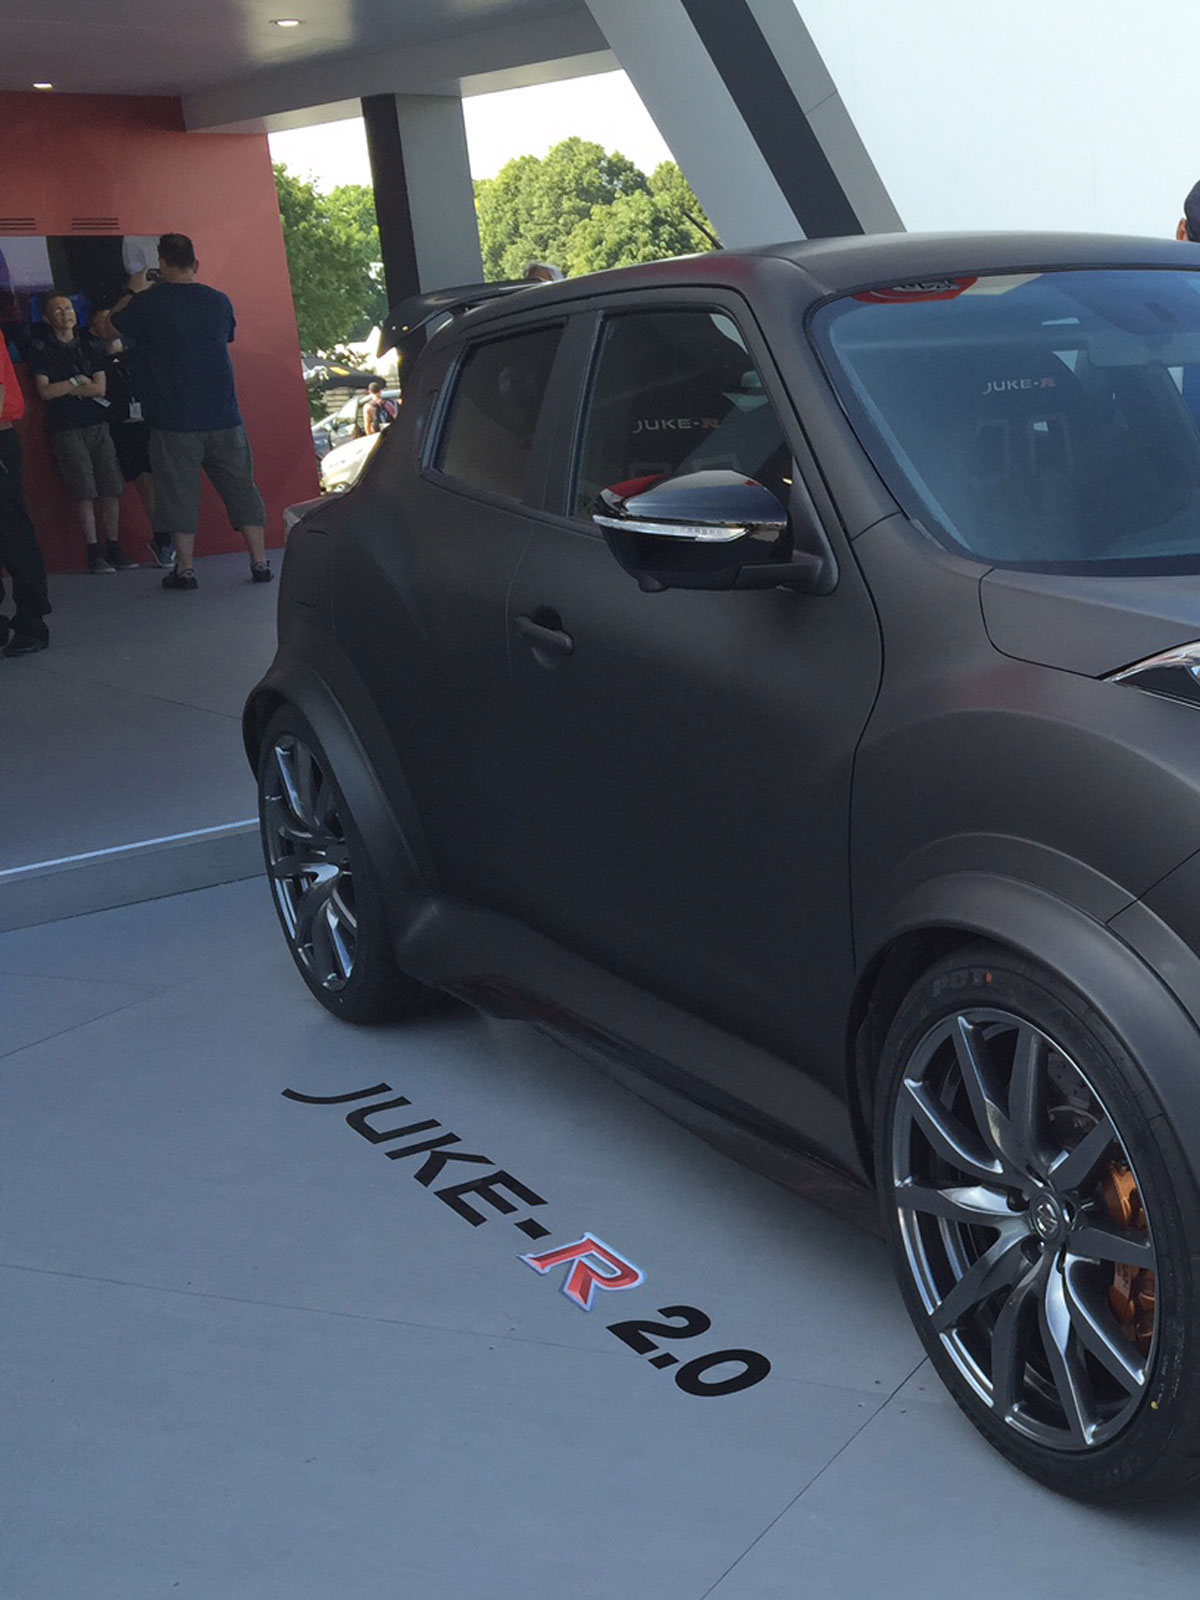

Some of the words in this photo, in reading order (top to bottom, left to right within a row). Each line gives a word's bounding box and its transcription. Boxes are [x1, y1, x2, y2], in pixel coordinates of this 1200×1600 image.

[982, 379, 1056, 395] JUKE-R
[632, 418, 720, 434] JUKE-R
[281, 1082, 647, 1312] JUKE-R
[606, 1305, 771, 1397] 2.0
